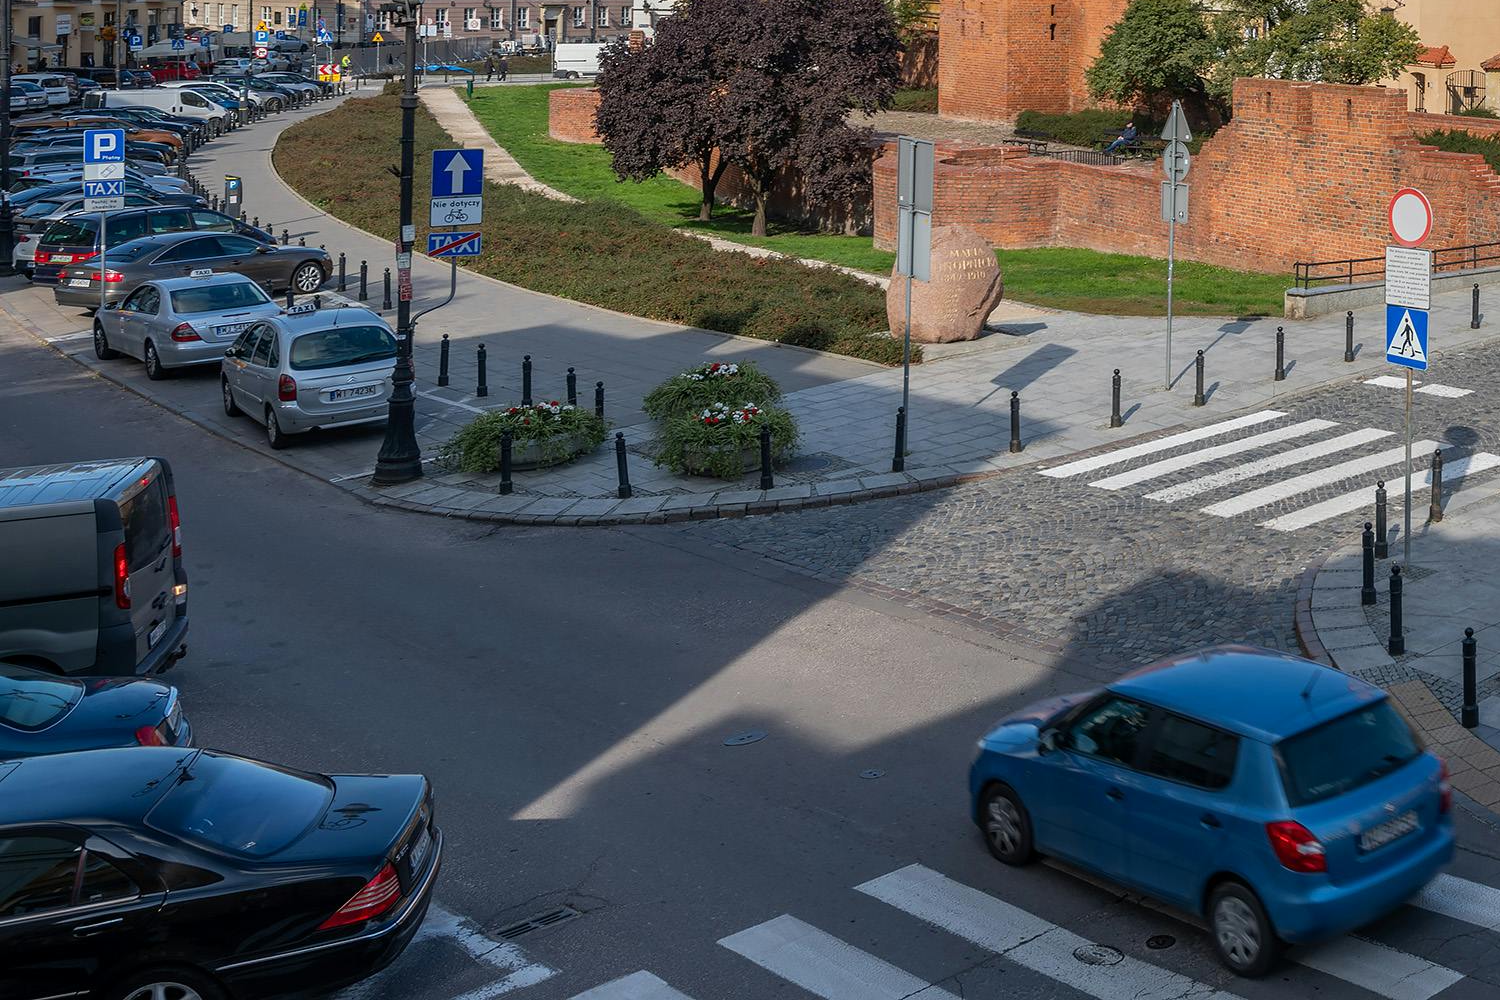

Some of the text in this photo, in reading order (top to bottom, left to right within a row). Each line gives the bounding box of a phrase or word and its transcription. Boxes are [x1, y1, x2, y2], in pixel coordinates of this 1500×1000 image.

[132, 36, 140, 44] P
[257, 32, 265, 40] P
[94, 134, 116, 159] P
[86, 182, 123, 196] TAXI
[450, 200, 480, 208] dotyczy
[431, 235, 479, 253] TAXI
[292, 304, 314, 313] TAXI
